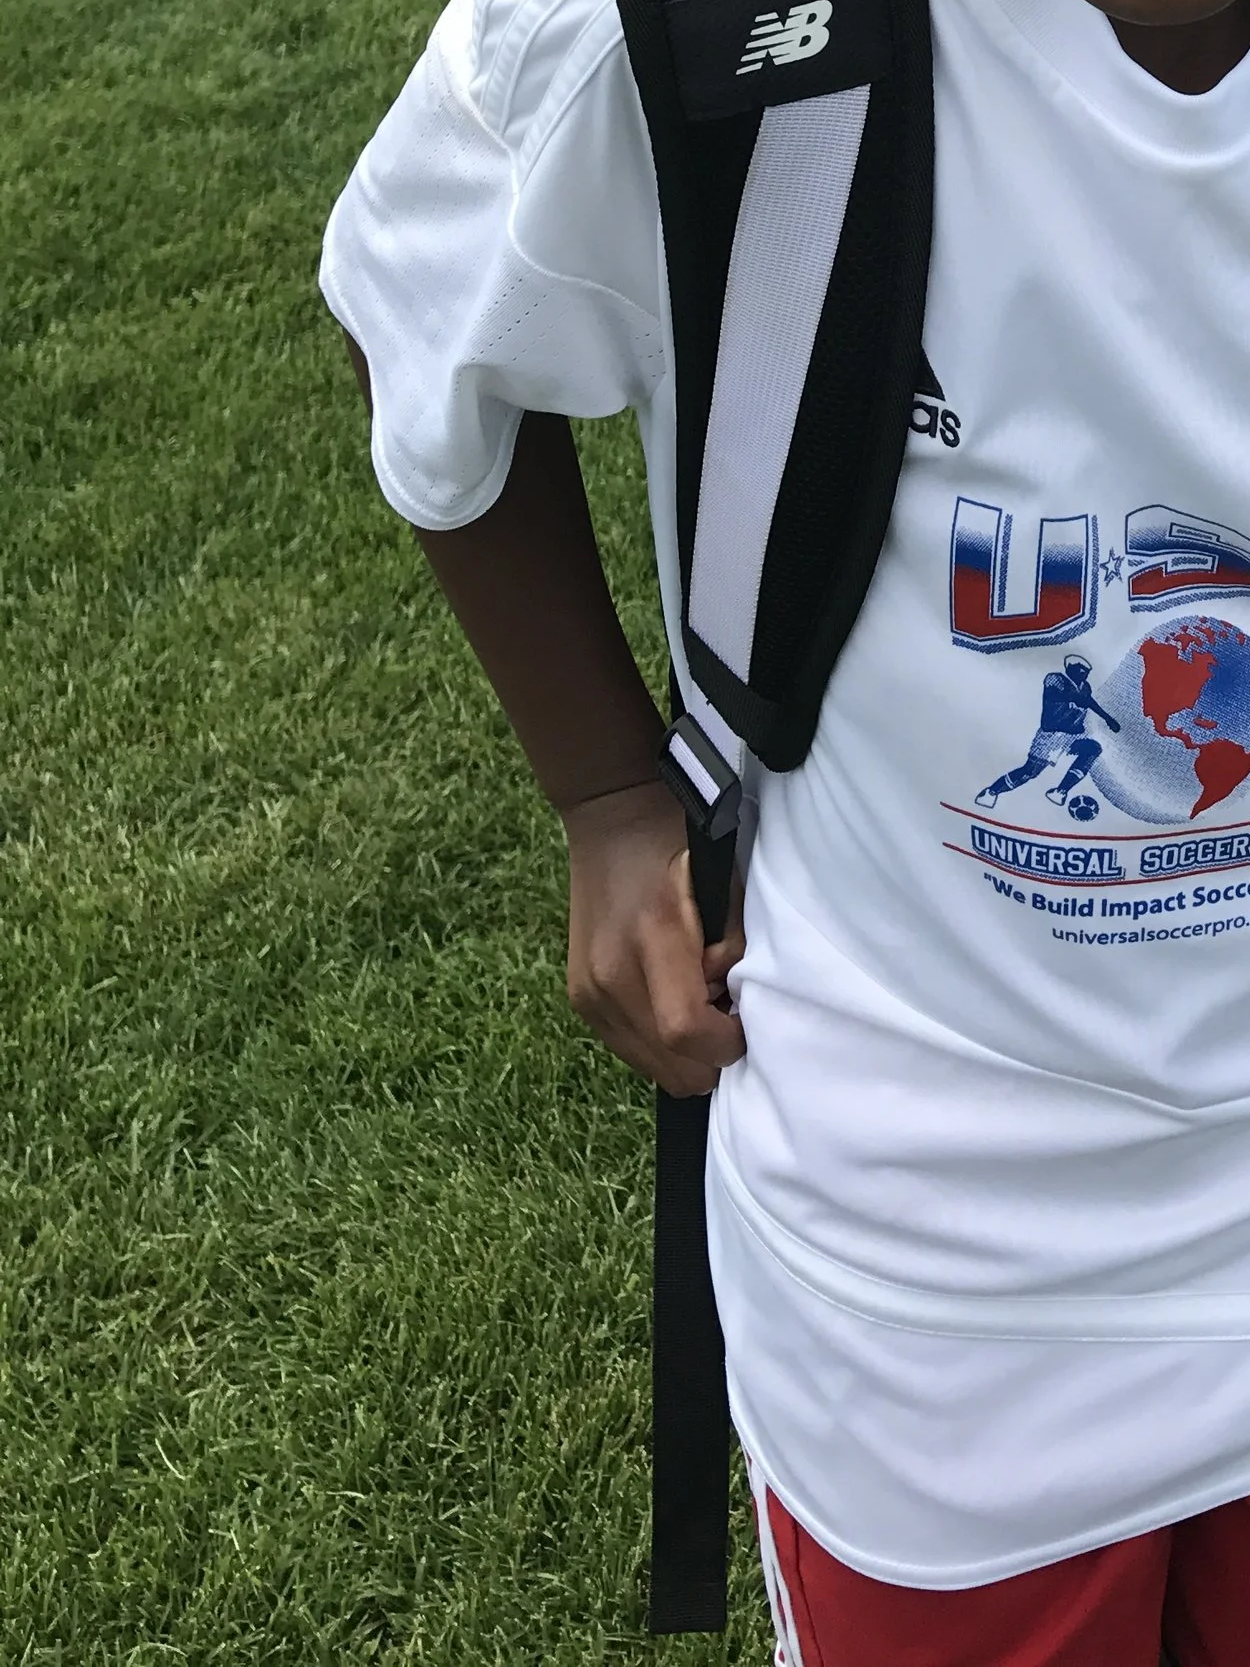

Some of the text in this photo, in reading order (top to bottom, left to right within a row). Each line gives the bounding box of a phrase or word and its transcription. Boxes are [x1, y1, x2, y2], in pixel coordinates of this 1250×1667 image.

[736, 0, 834, 76] NB
[971, 825, 1126, 882] UNIVERSAL
[984, 872, 1026, 904] "We
[1032, 893, 1094, 917] Build
[1101, 891, 1186, 920] Impact
